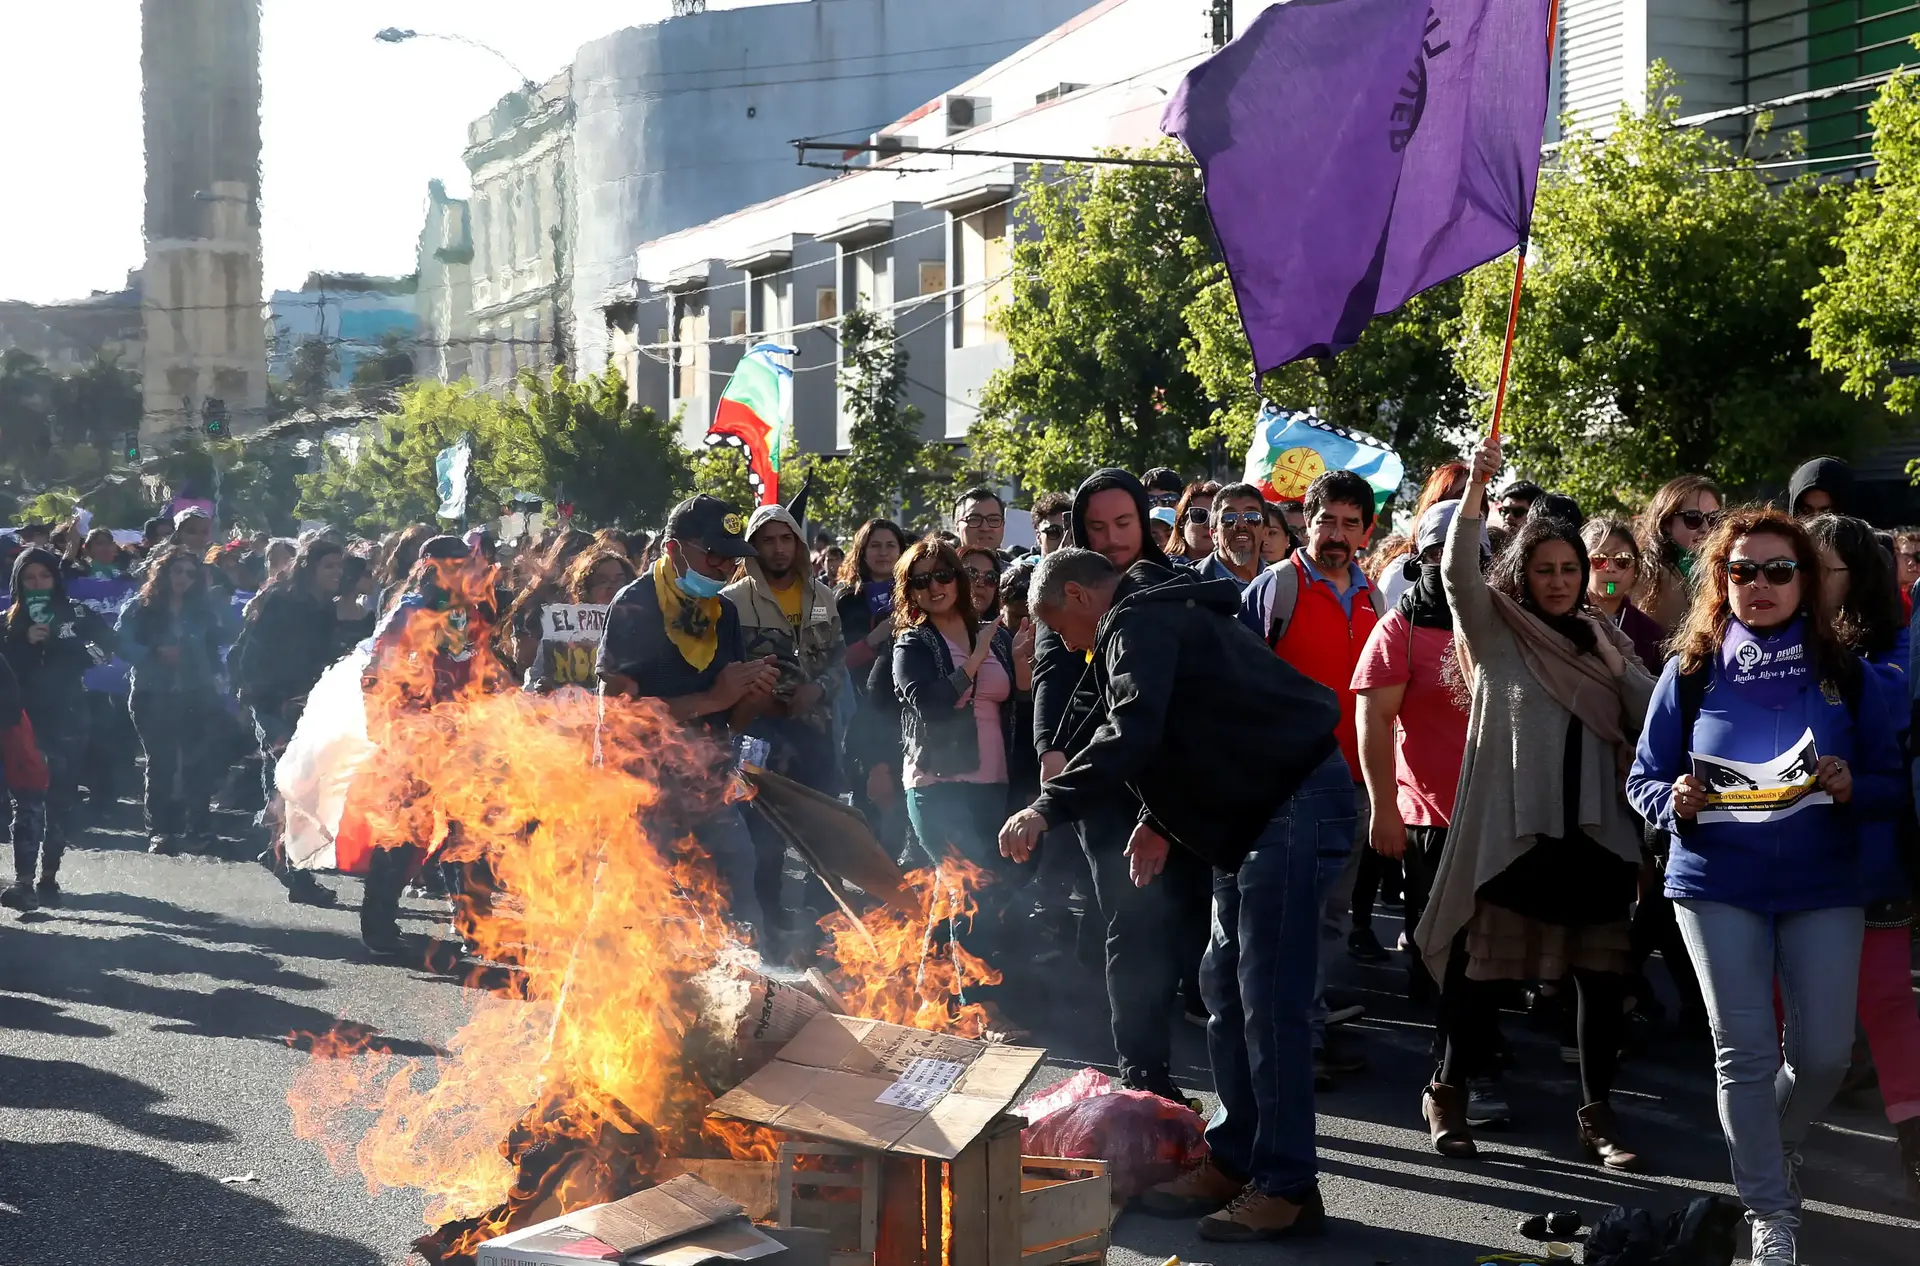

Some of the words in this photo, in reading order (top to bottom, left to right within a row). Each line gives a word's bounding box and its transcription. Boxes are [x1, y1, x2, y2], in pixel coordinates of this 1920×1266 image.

[552, 609, 575, 632] EL
[1776, 643, 1804, 659] DEVOTA
[1733, 672, 1756, 684] Linda
[1757, 670, 1780, 680] Libre
[1787, 666, 1806, 676] Loca
